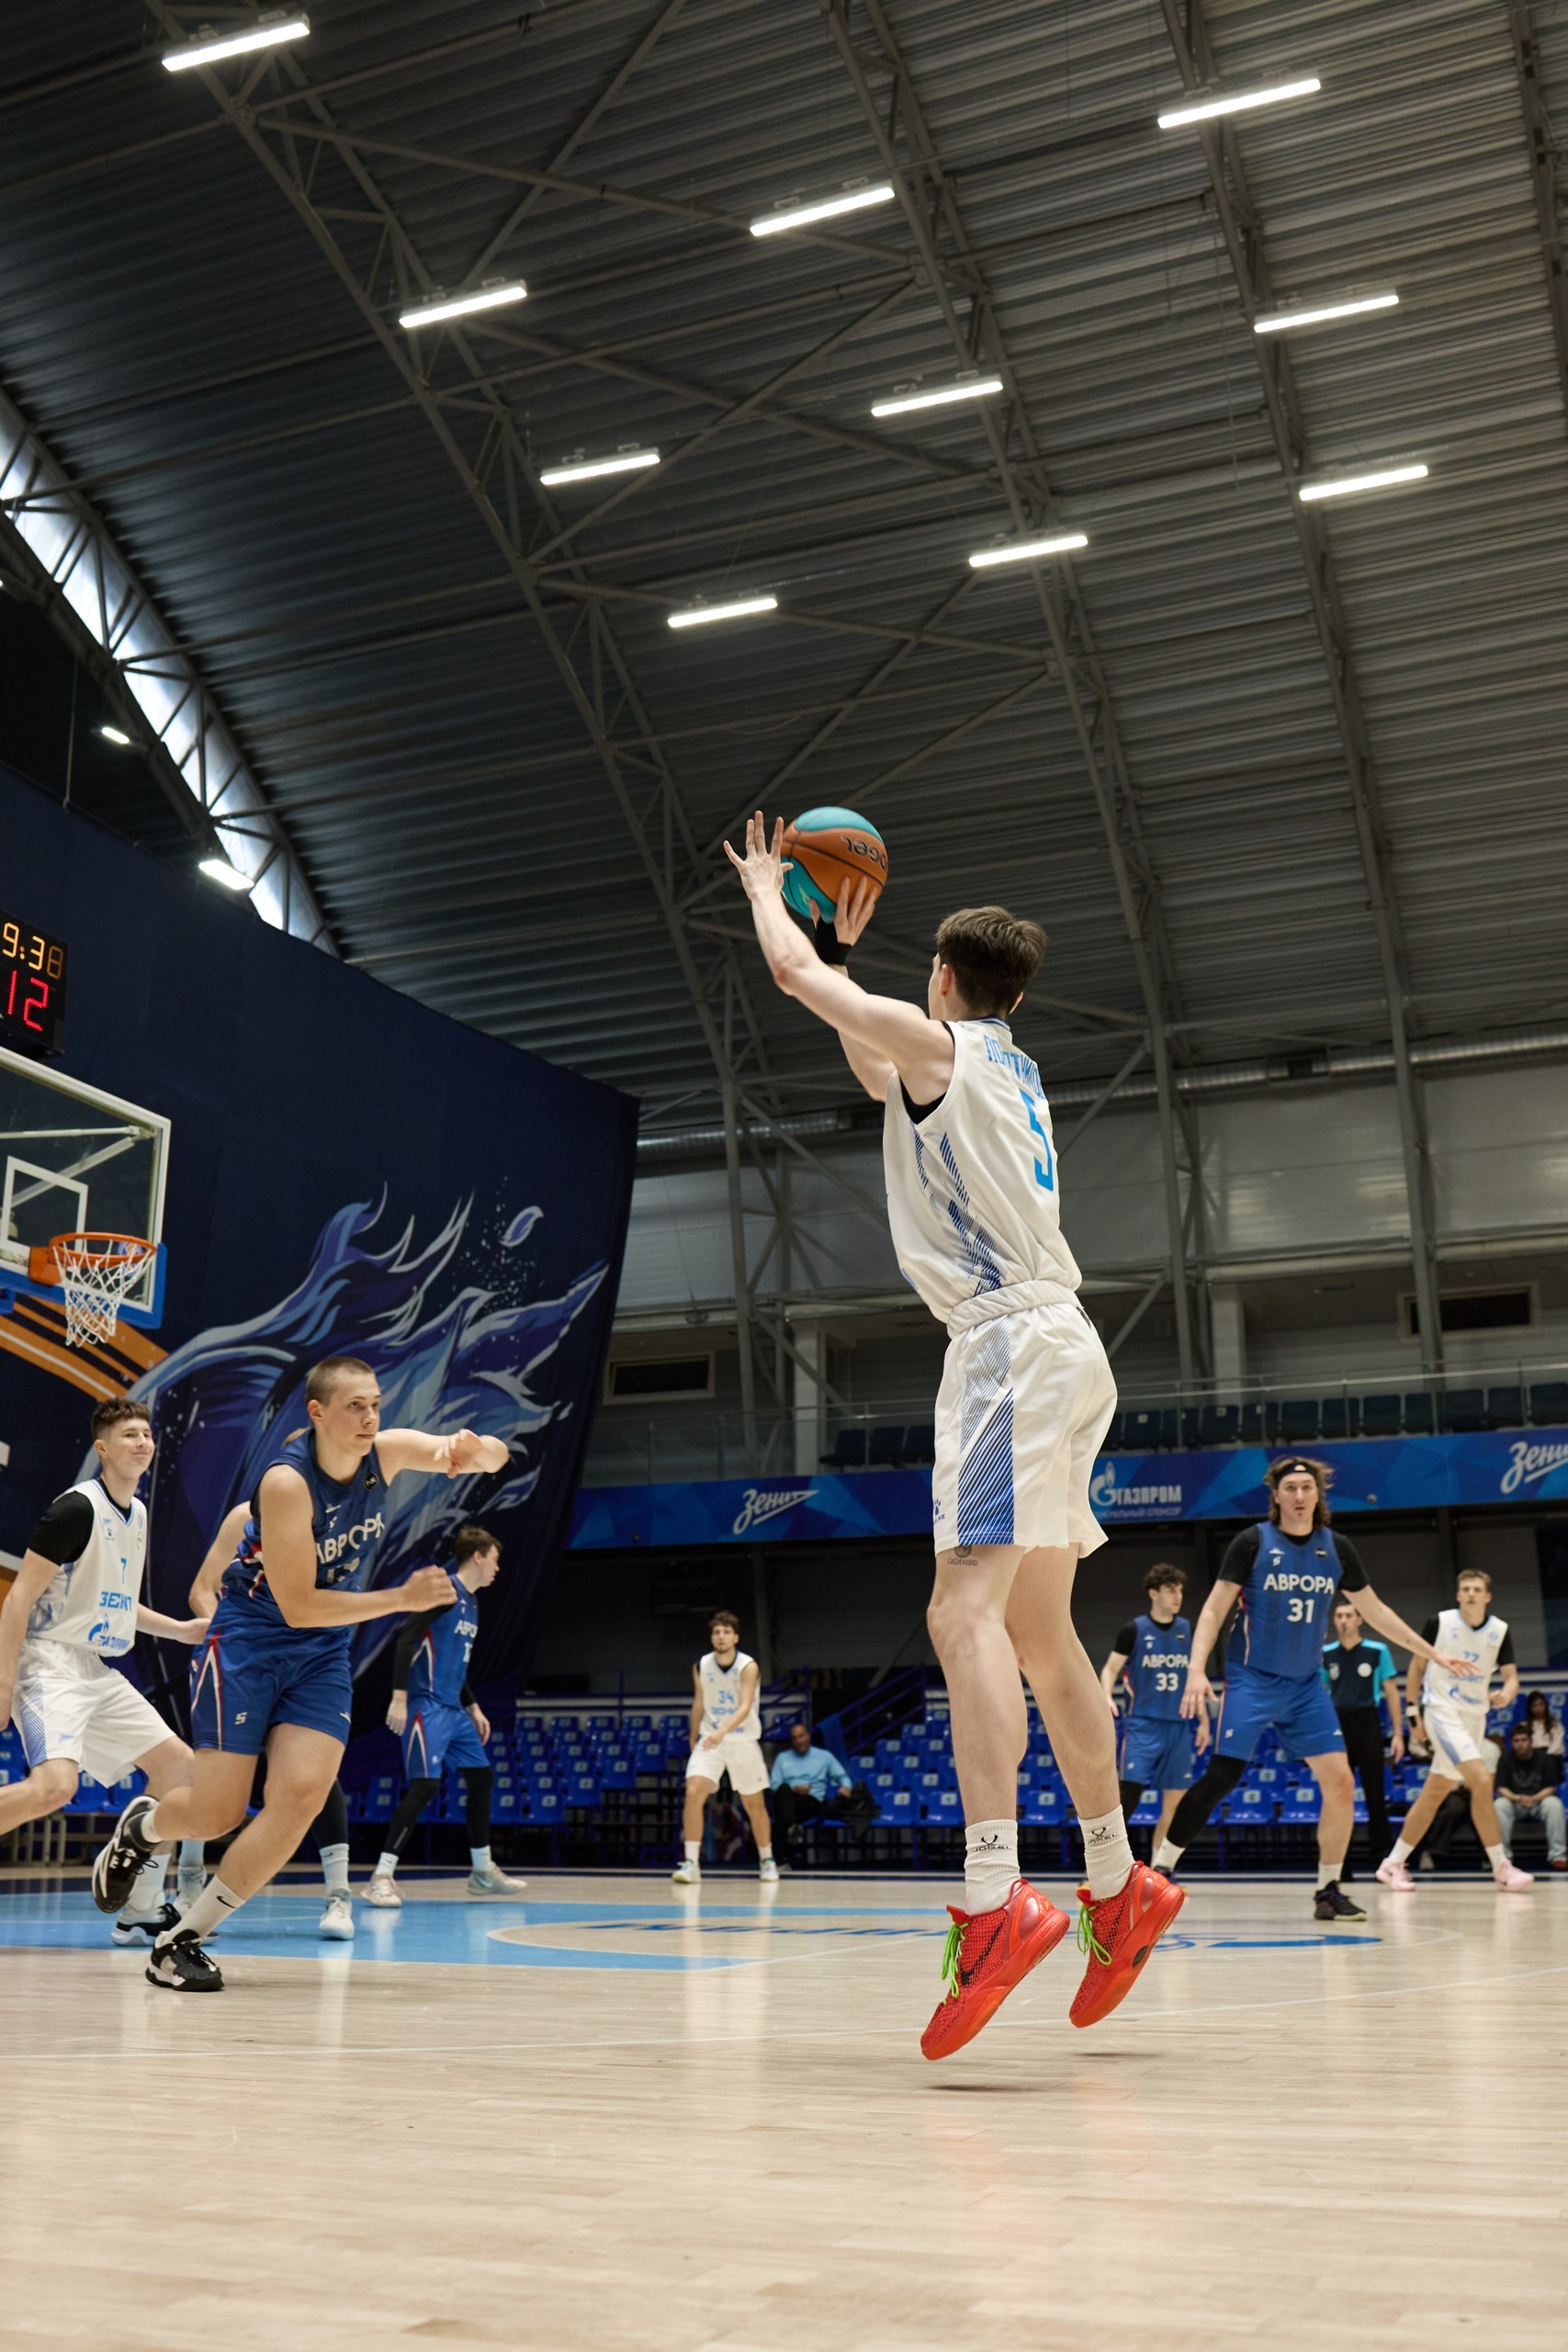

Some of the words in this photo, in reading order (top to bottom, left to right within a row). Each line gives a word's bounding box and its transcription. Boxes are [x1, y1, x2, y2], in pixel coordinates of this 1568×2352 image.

[7, 969, 50, 1031] 12
[1019, 1088, 1054, 1192] 5
[1500, 1441, 1568, 1495] Зени
[1117, 1485, 1182, 1506] ГАЗПРОМ
[732, 1487, 819, 1535] Зенит
[120, 1557, 127, 1585] 7
[1263, 1573, 1335, 1595] АВРОРА
[1287, 1598, 1314, 1623] 31
[1142, 1654, 1189, 1668] АВРОРА
[1155, 1672, 1179, 1691] 33
